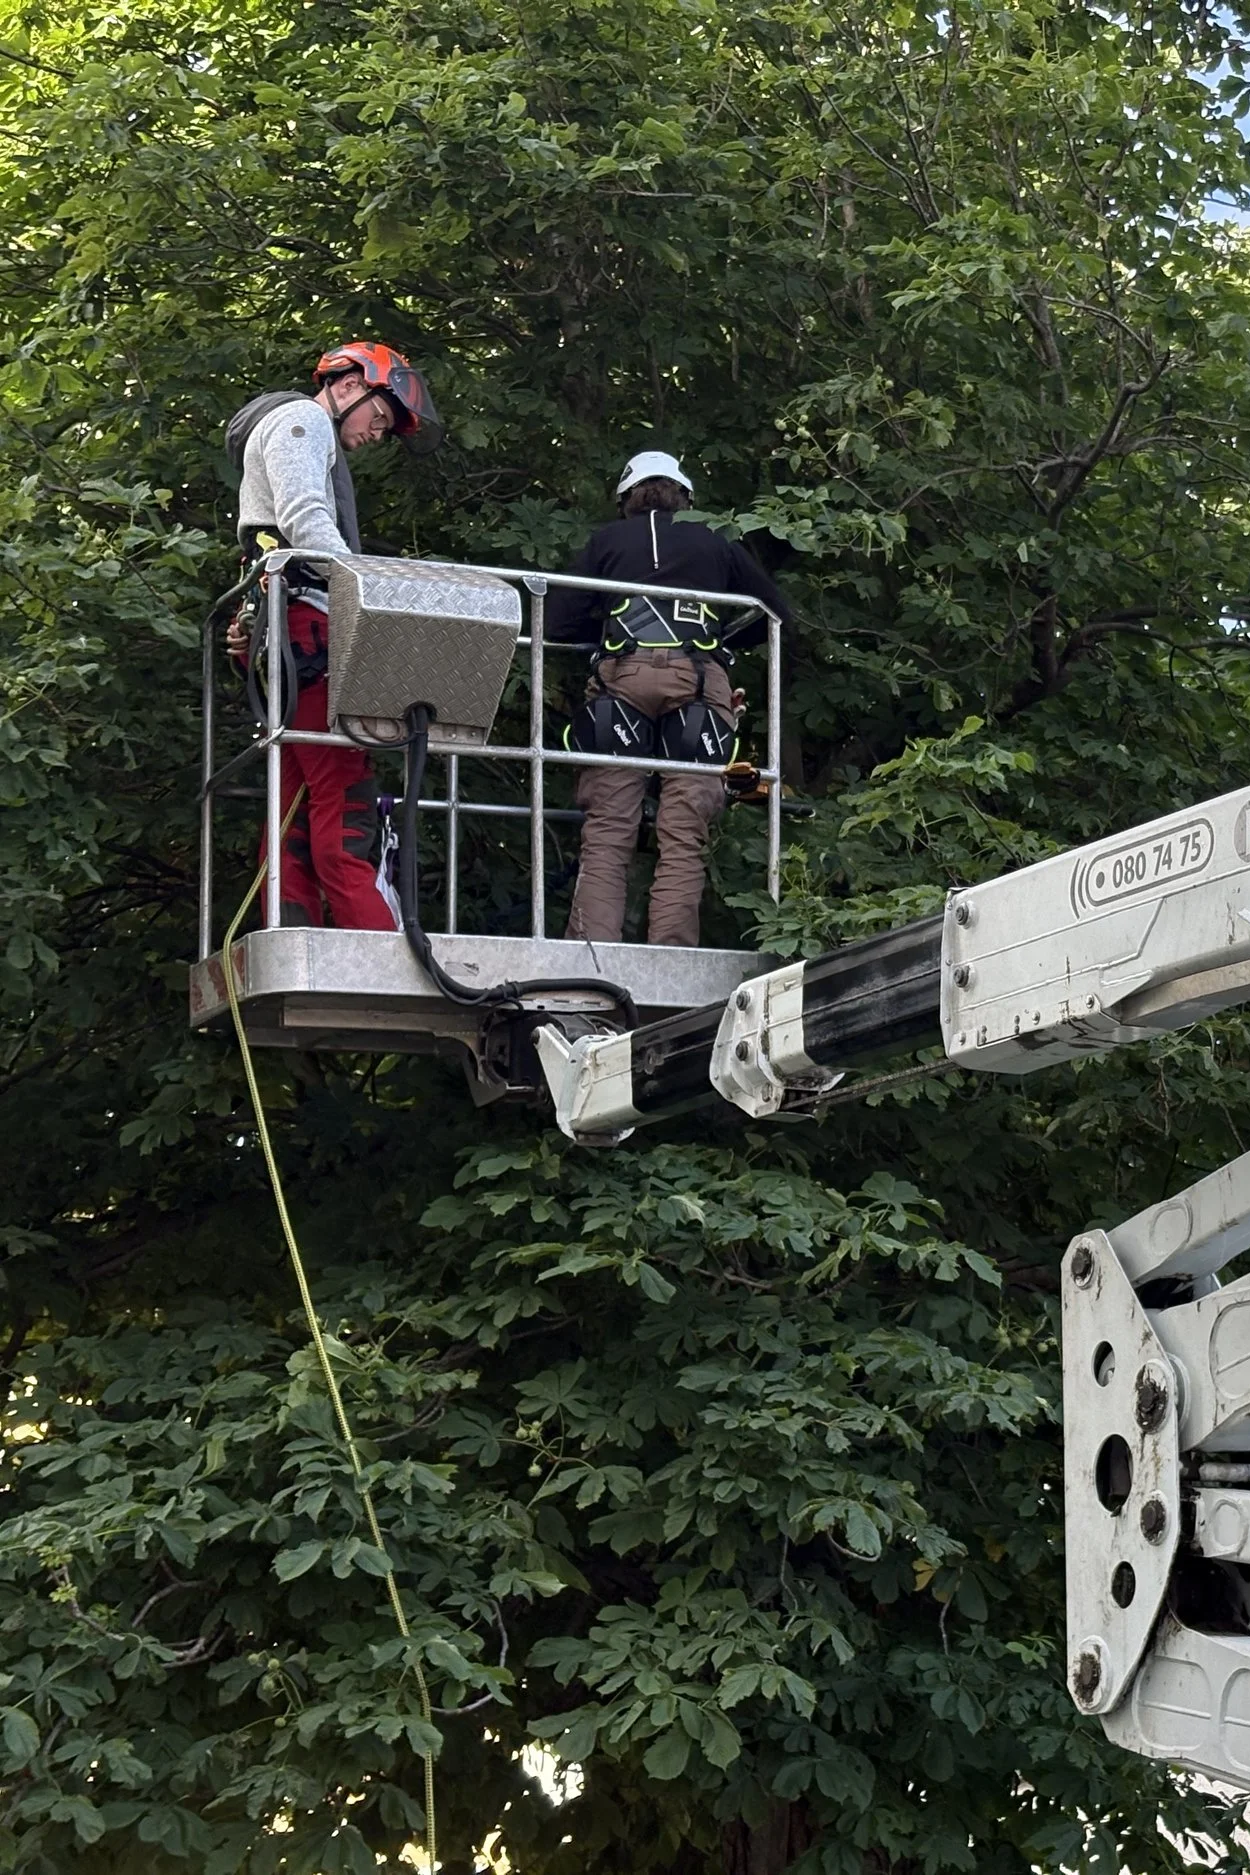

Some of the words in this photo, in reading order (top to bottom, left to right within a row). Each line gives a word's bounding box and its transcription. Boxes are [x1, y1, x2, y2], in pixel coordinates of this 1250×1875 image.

[1112, 851, 1147, 889] 080
[1152, 841, 1173, 876] 74
[1179, 830, 1201, 867] 75
